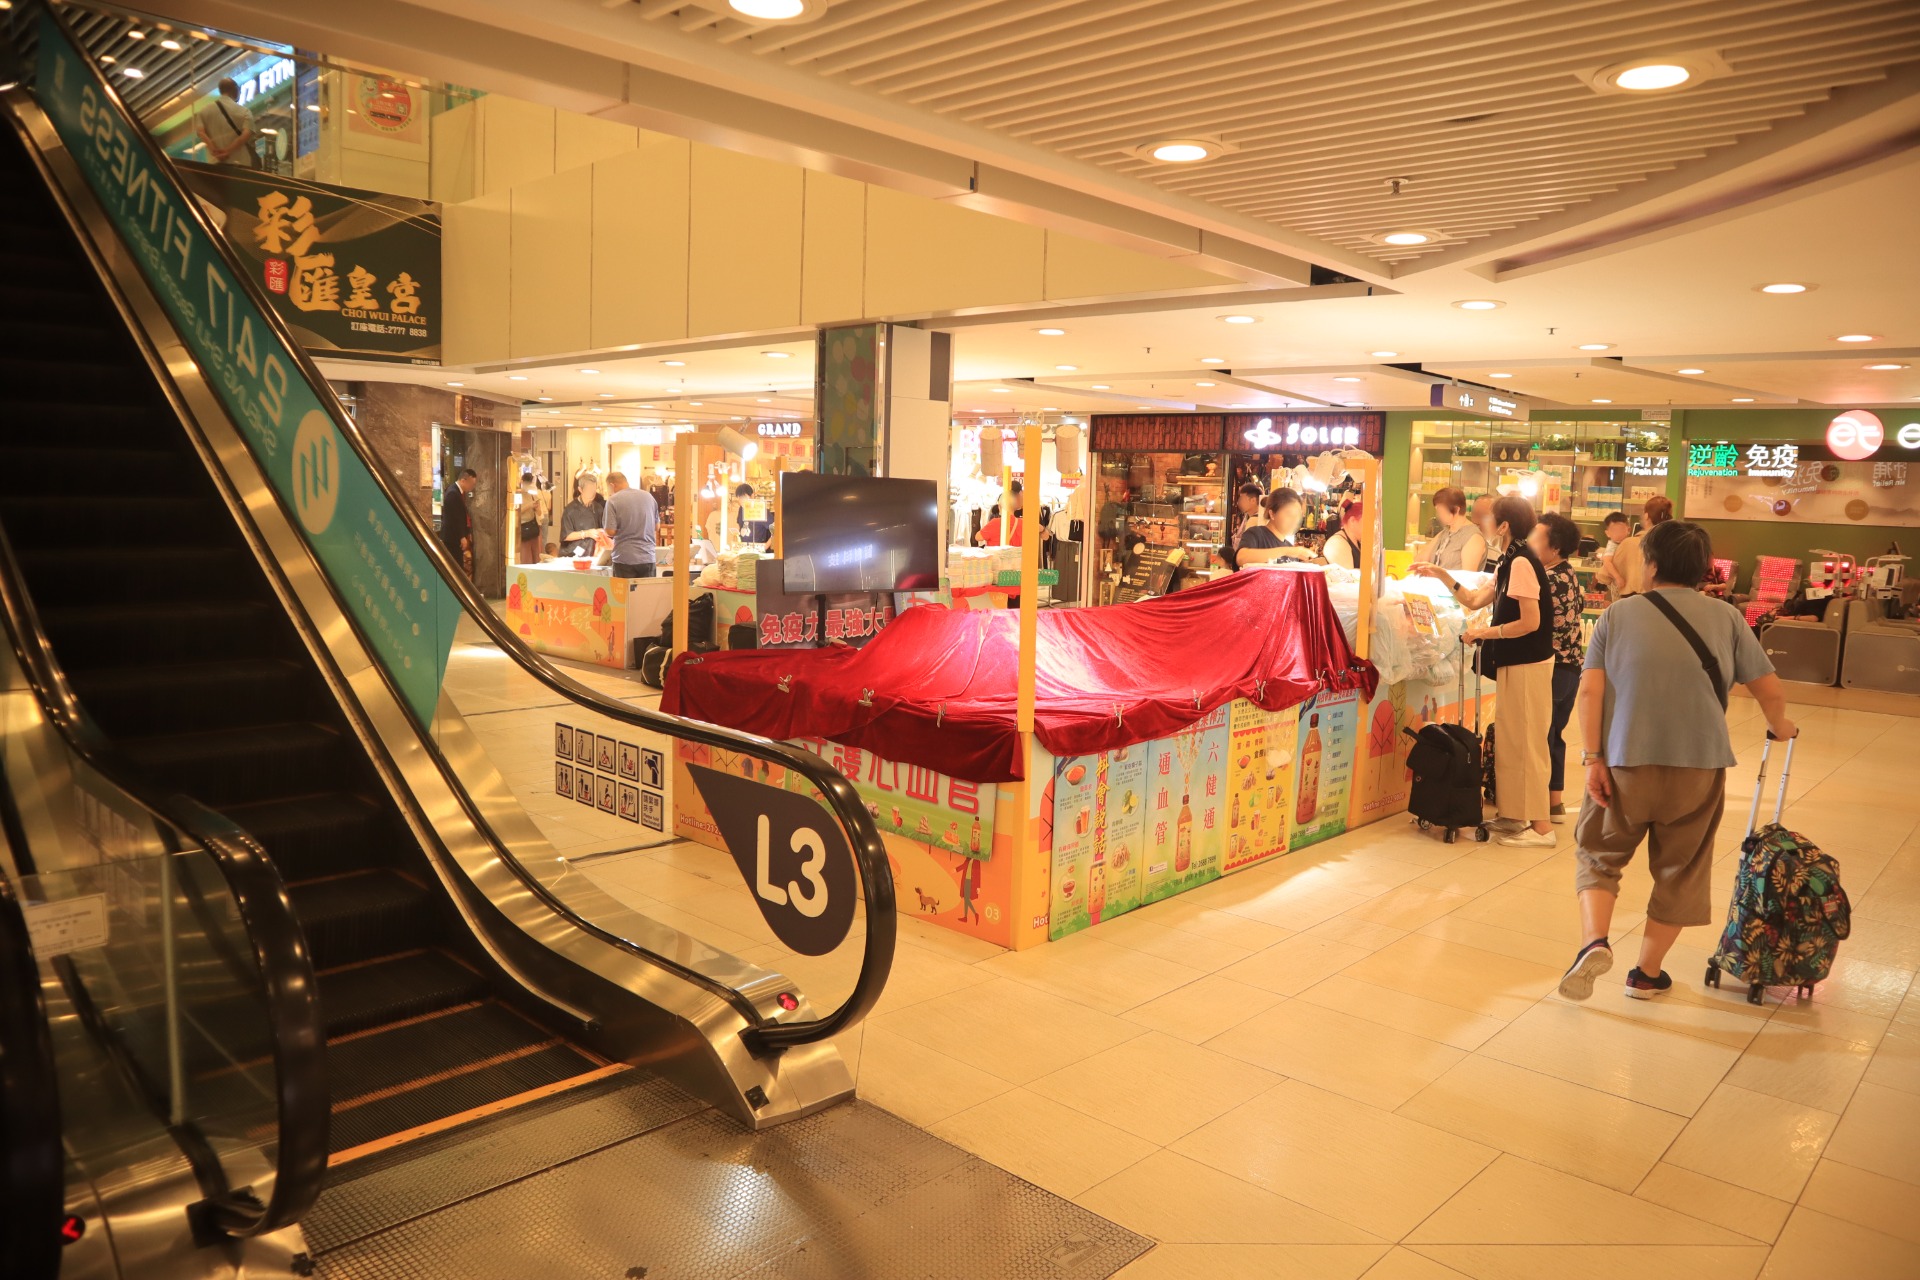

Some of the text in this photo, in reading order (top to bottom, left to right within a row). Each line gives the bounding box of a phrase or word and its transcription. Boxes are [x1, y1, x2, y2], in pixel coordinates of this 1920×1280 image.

[269, 260, 284, 292] 彩匯
[341, 308, 427, 325] CHOI WUI PALACE
[757, 423, 801, 436] GRAND
[1689, 443, 1739, 468] 逆齡
[1745, 443, 1798, 468] 免疫
[1688, 469, 1738, 477] Rejuvenation
[1748, 469, 1795, 477] Immunity
[1203, 741, 1221, 830] 六健通
[1154, 751, 1172, 847] 通血管
[680, 814, 706, 830] Hotline:
[756, 813, 829, 918] L3
[985, 906, 1000, 921] 03
